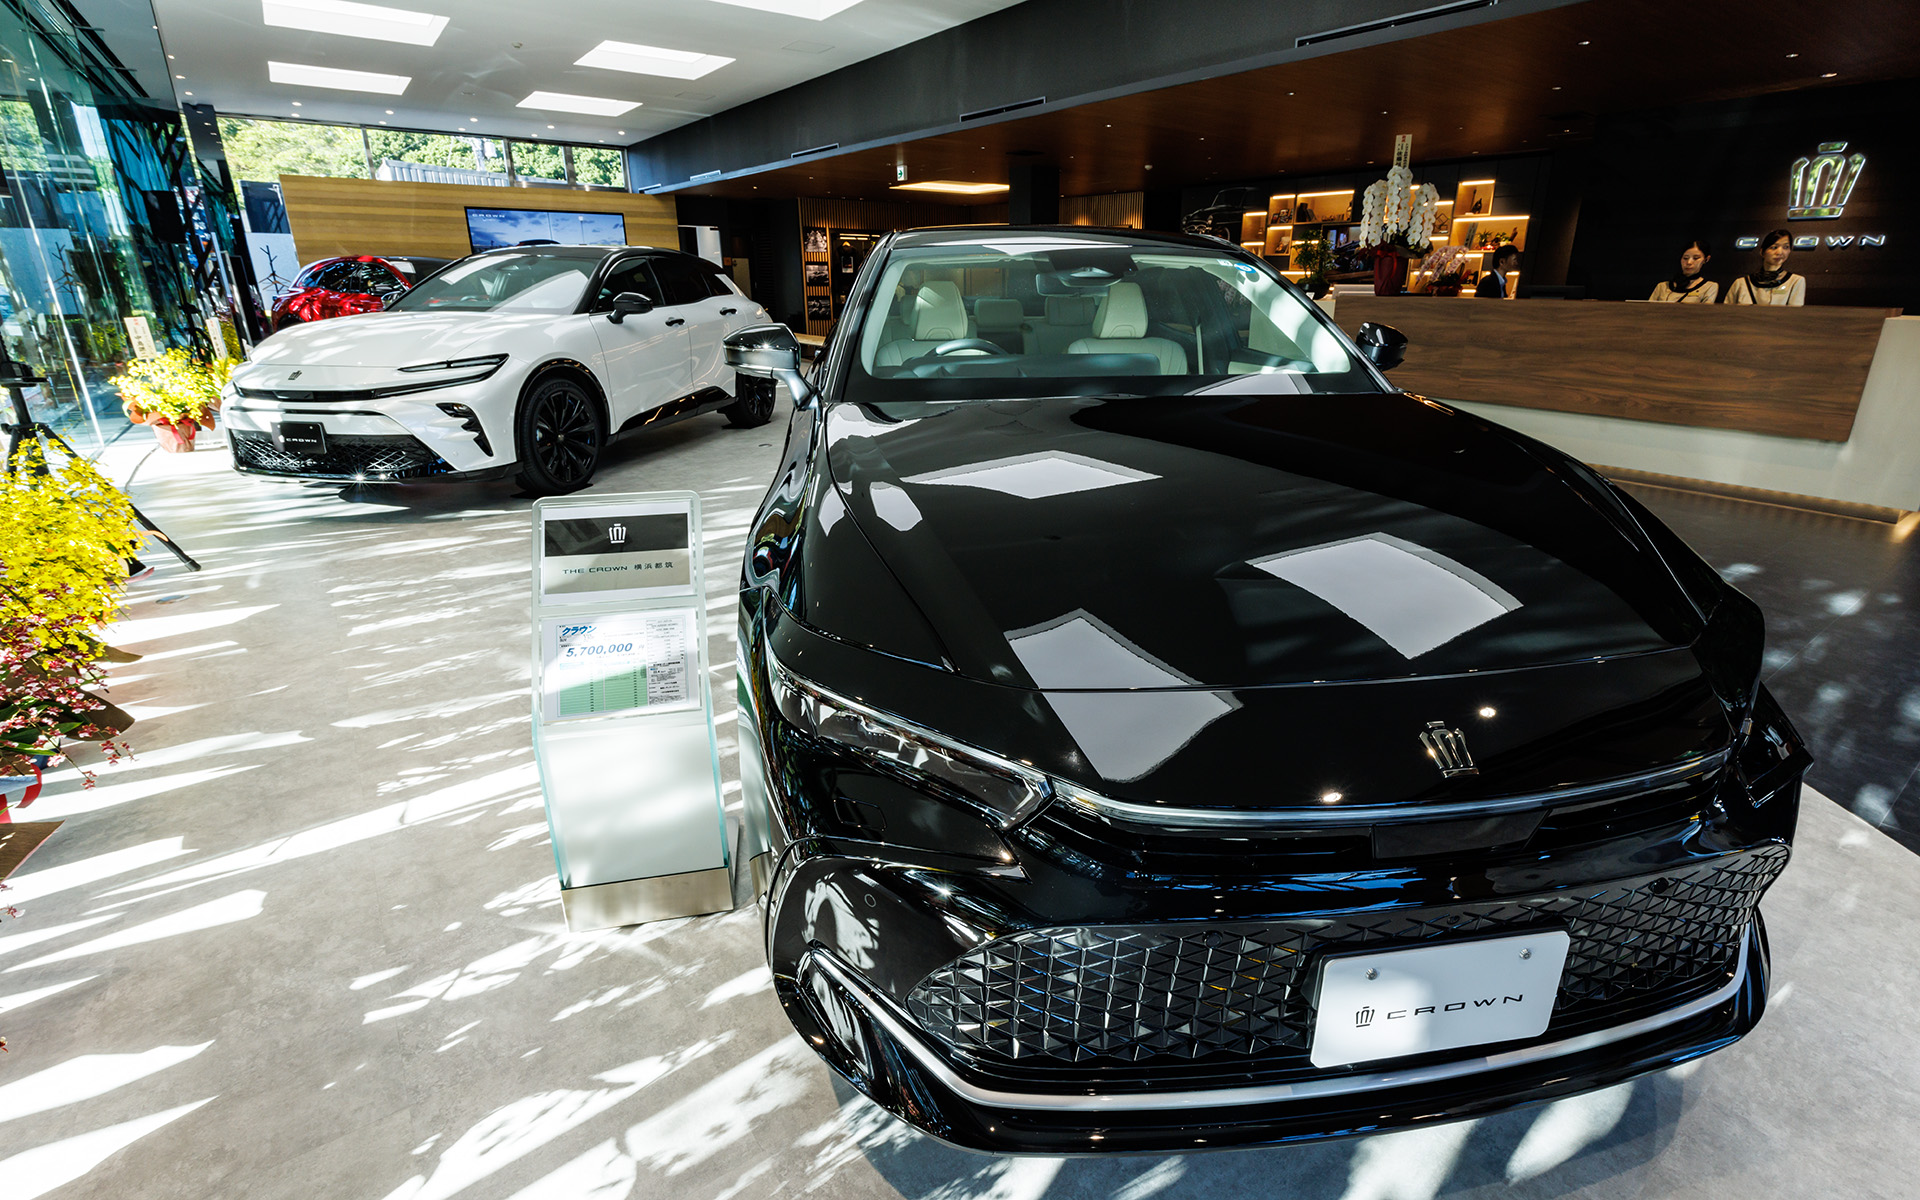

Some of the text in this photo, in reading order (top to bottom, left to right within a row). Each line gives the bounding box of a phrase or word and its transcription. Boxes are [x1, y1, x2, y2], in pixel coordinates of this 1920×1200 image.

[1735, 234, 1886, 249] COWN
[588, 565, 628, 573] CROWN
[634, 561, 673, 570] 横浜都筑
[562, 625, 597, 636] クラウン
[566, 642, 633, 658] 5,700,000
[1387, 994, 1523, 1020] CROWN
